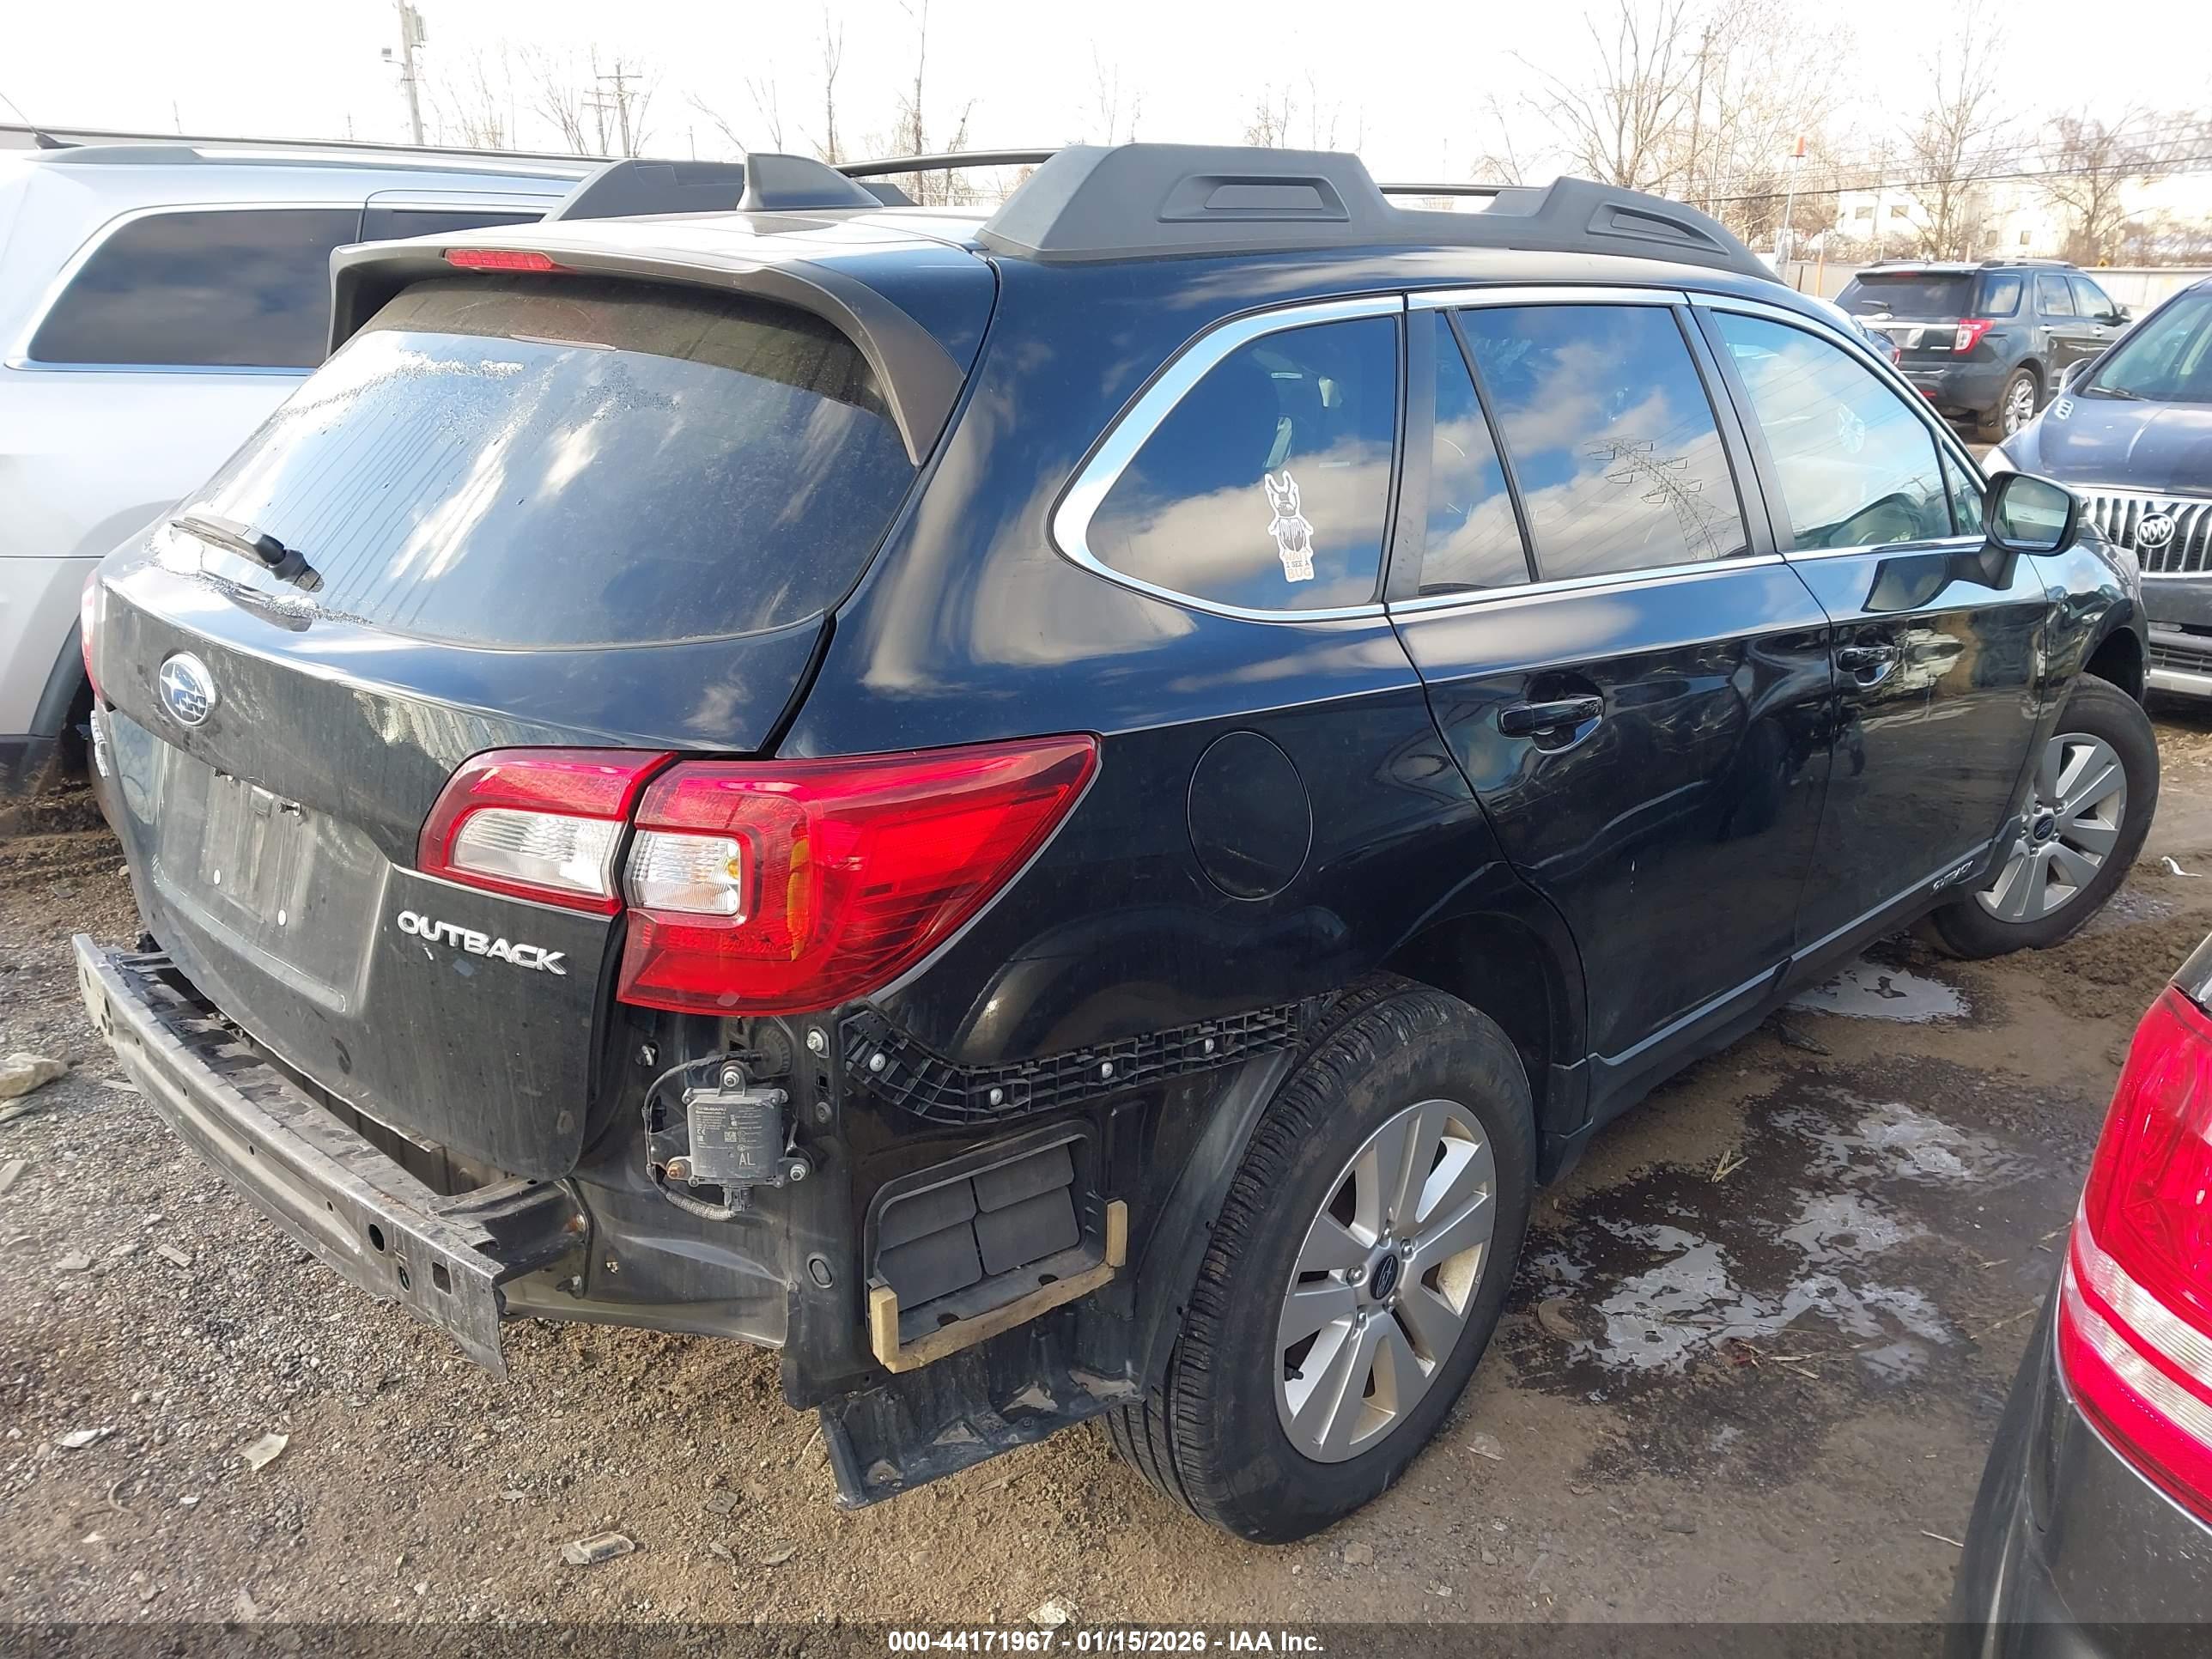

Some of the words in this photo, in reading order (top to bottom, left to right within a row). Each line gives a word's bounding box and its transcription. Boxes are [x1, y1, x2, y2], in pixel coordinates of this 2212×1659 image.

[1284, 550, 1307, 561] WAIT
[1287, 568, 1311, 579] BUG
[397, 910, 568, 975] OUTBACK
[738, 1152, 757, 1167] AL
